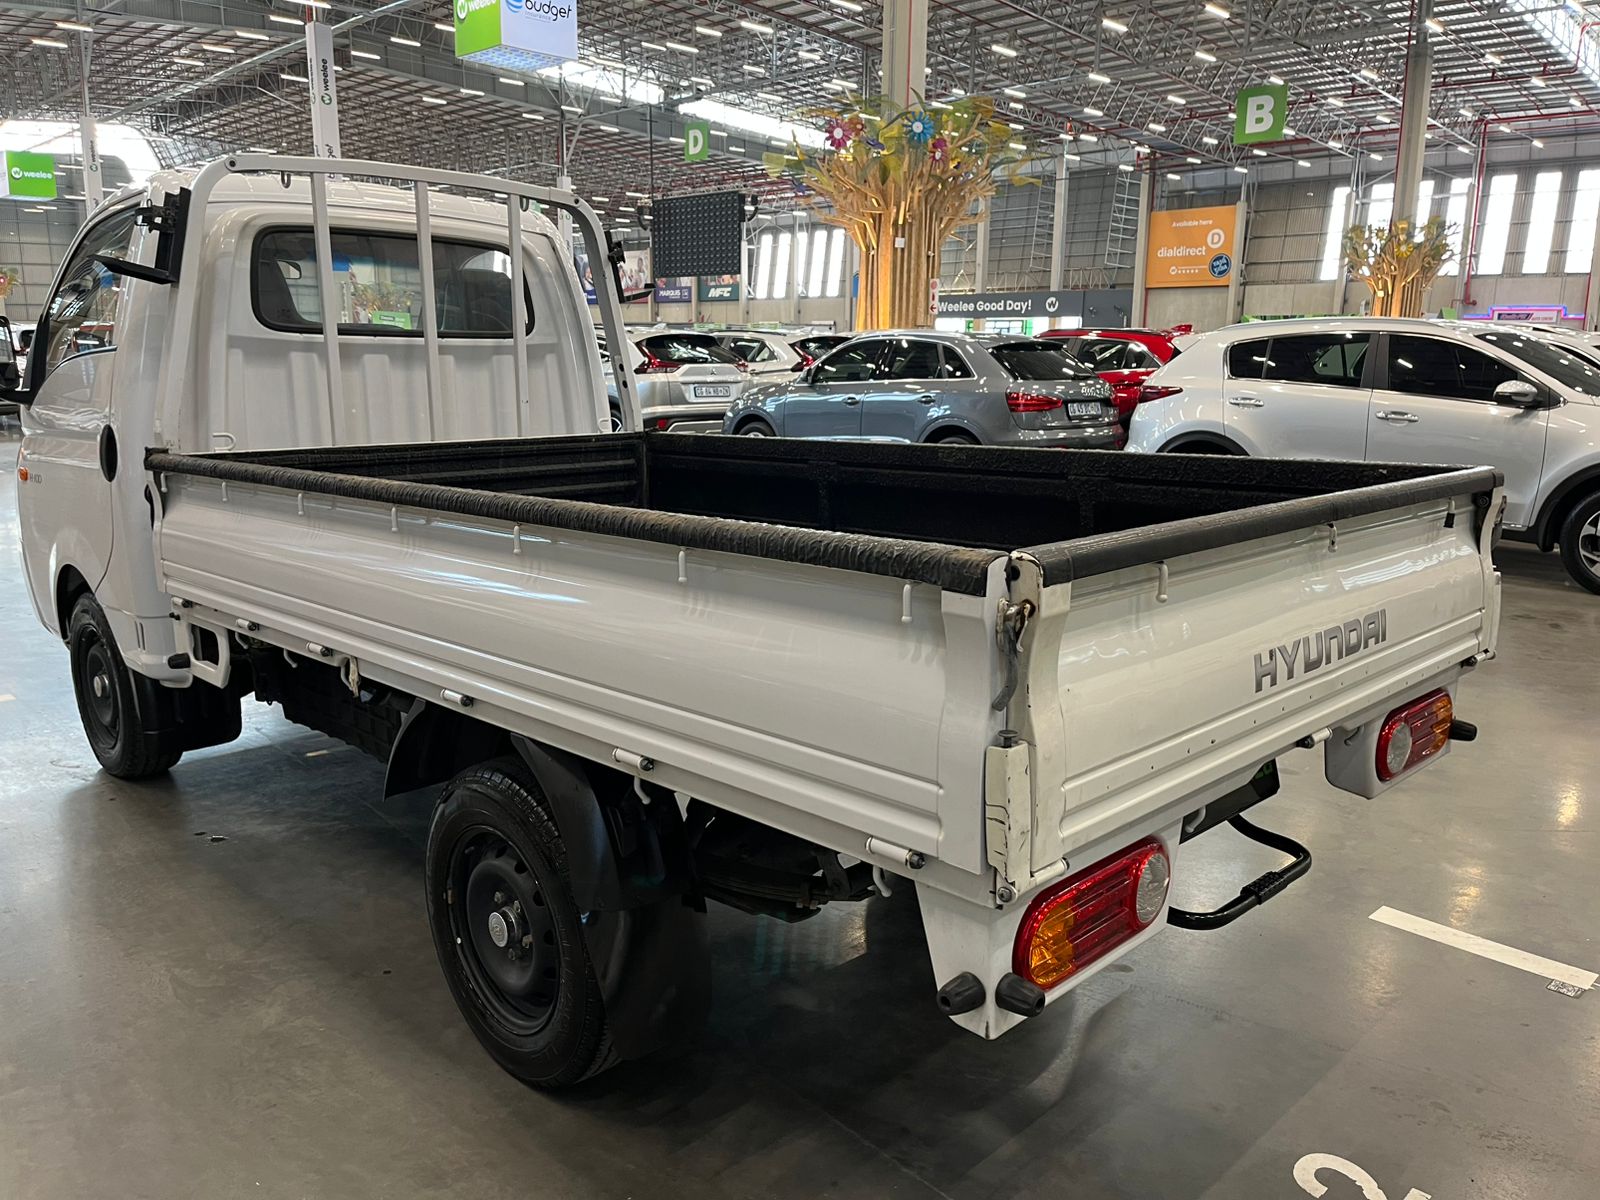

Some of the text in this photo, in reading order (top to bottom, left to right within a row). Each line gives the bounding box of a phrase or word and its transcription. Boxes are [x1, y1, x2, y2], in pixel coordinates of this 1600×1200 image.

[321, 58, 329, 91] weelee
[1245, 95, 1275, 134] B
[688, 129, 704, 155] D
[1157, 246, 1206, 257] dialdirect
[708, 287, 731, 297] MFC
[938, 301, 974, 313] Weelee
[976, 299, 1005, 312] Good
[1006, 299, 1032, 314] Day!
[1253, 608, 1387, 694] HYUNDAI
